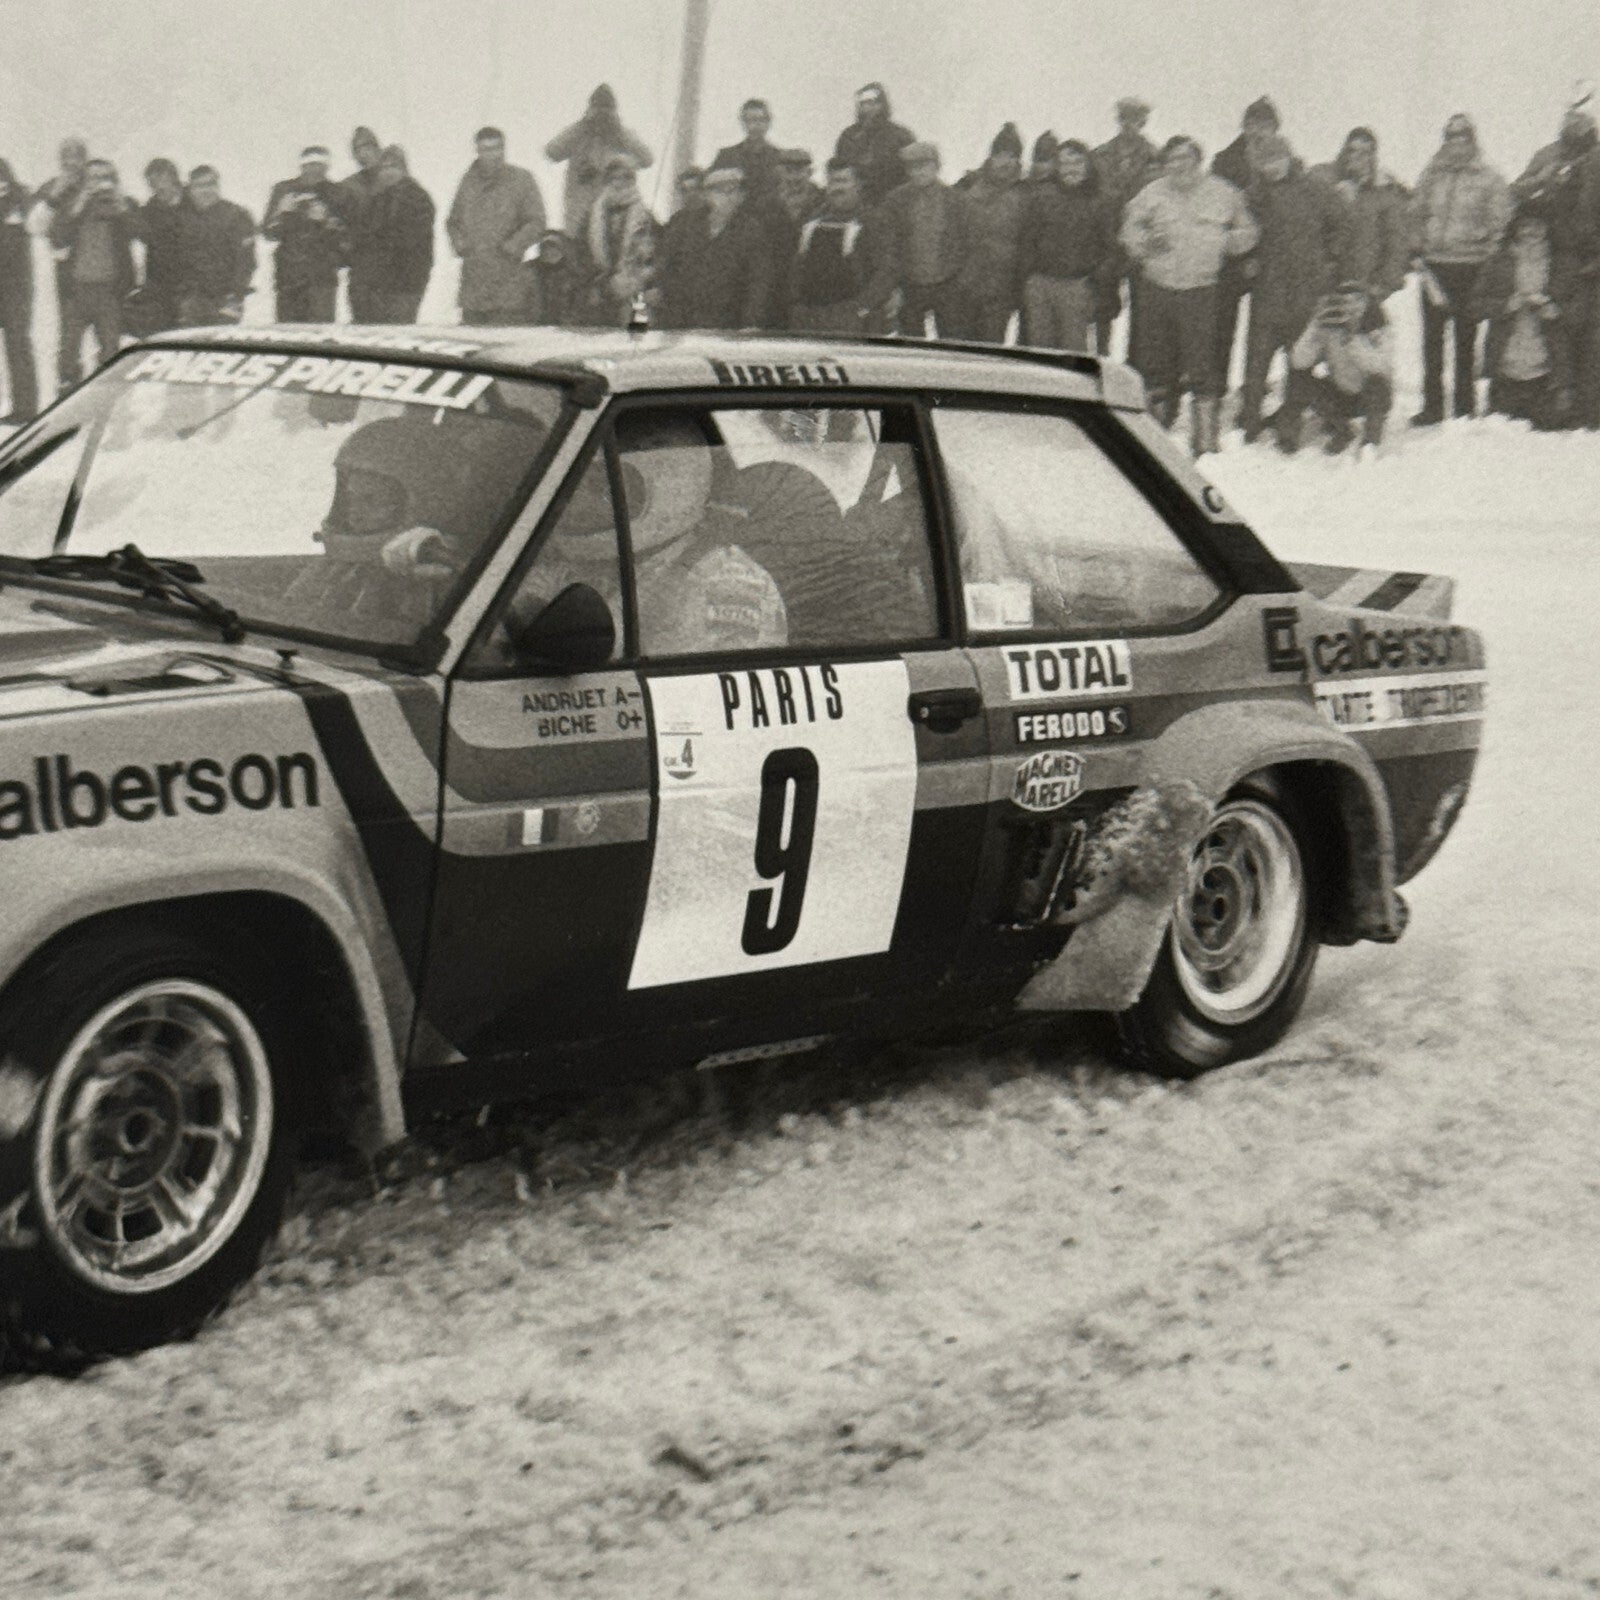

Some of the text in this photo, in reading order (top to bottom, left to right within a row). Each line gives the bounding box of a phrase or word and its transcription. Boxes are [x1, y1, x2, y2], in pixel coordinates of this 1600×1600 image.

[125, 351, 494, 409] PNEUS PIRELLI
[1008, 645, 1128, 693] TOTAL
[522, 688, 606, 713] ANDRUET
[718, 663, 843, 731] PARIS
[538, 714, 598, 738] BICHE
[1018, 710, 1106, 742] FERODO
[681, 738, 694, 769] 4
[741, 747, 819, 956] 9
